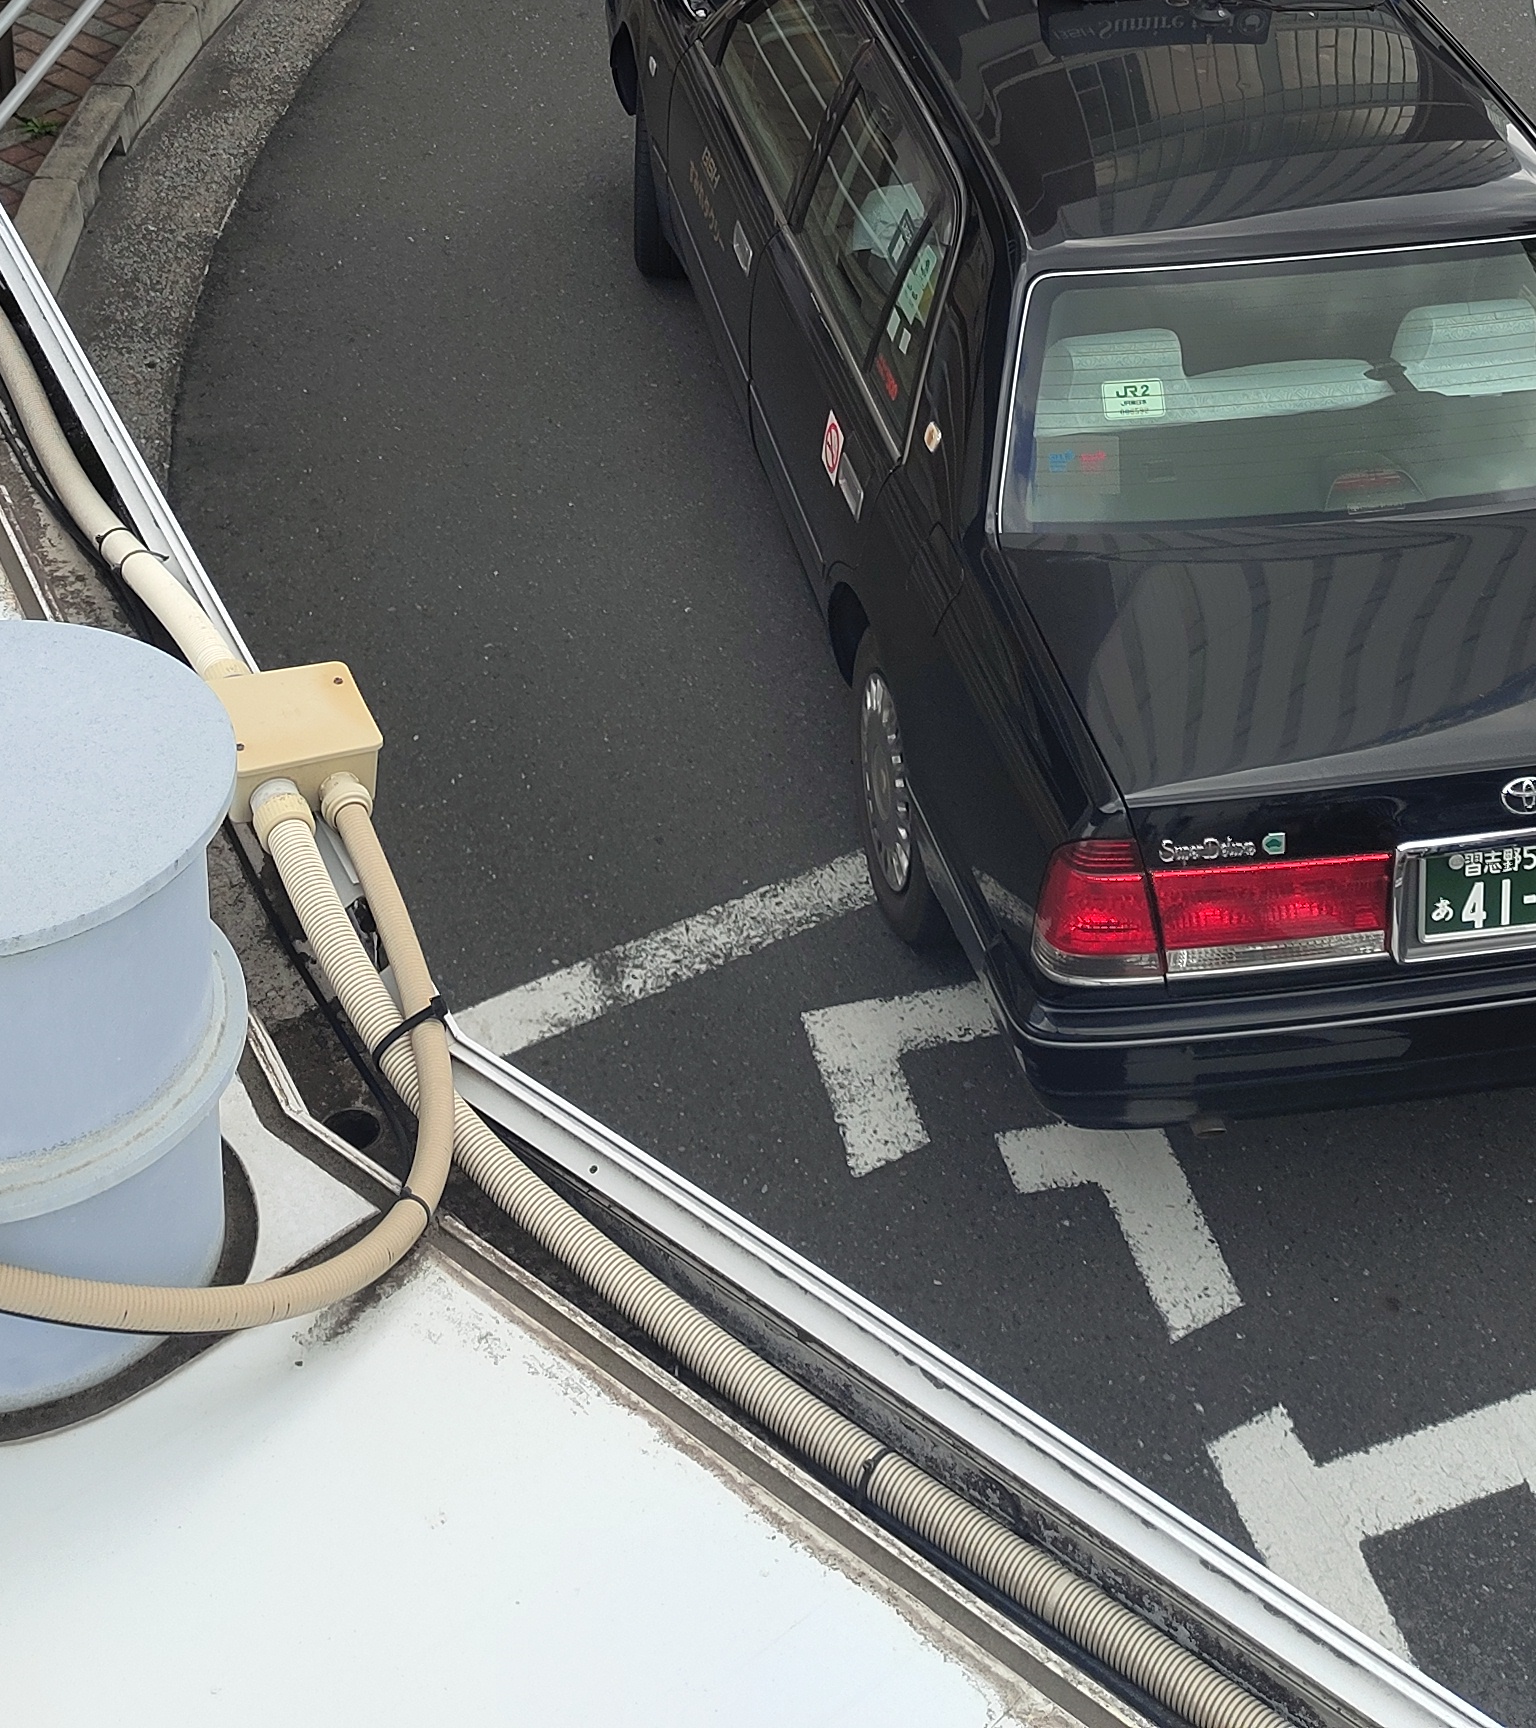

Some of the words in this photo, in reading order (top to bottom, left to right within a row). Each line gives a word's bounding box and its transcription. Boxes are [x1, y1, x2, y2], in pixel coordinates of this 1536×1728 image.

[1116, 385, 1139, 398] JR
[1141, 384, 1150, 397] 2
[1431, 896, 1454, 922] あ
